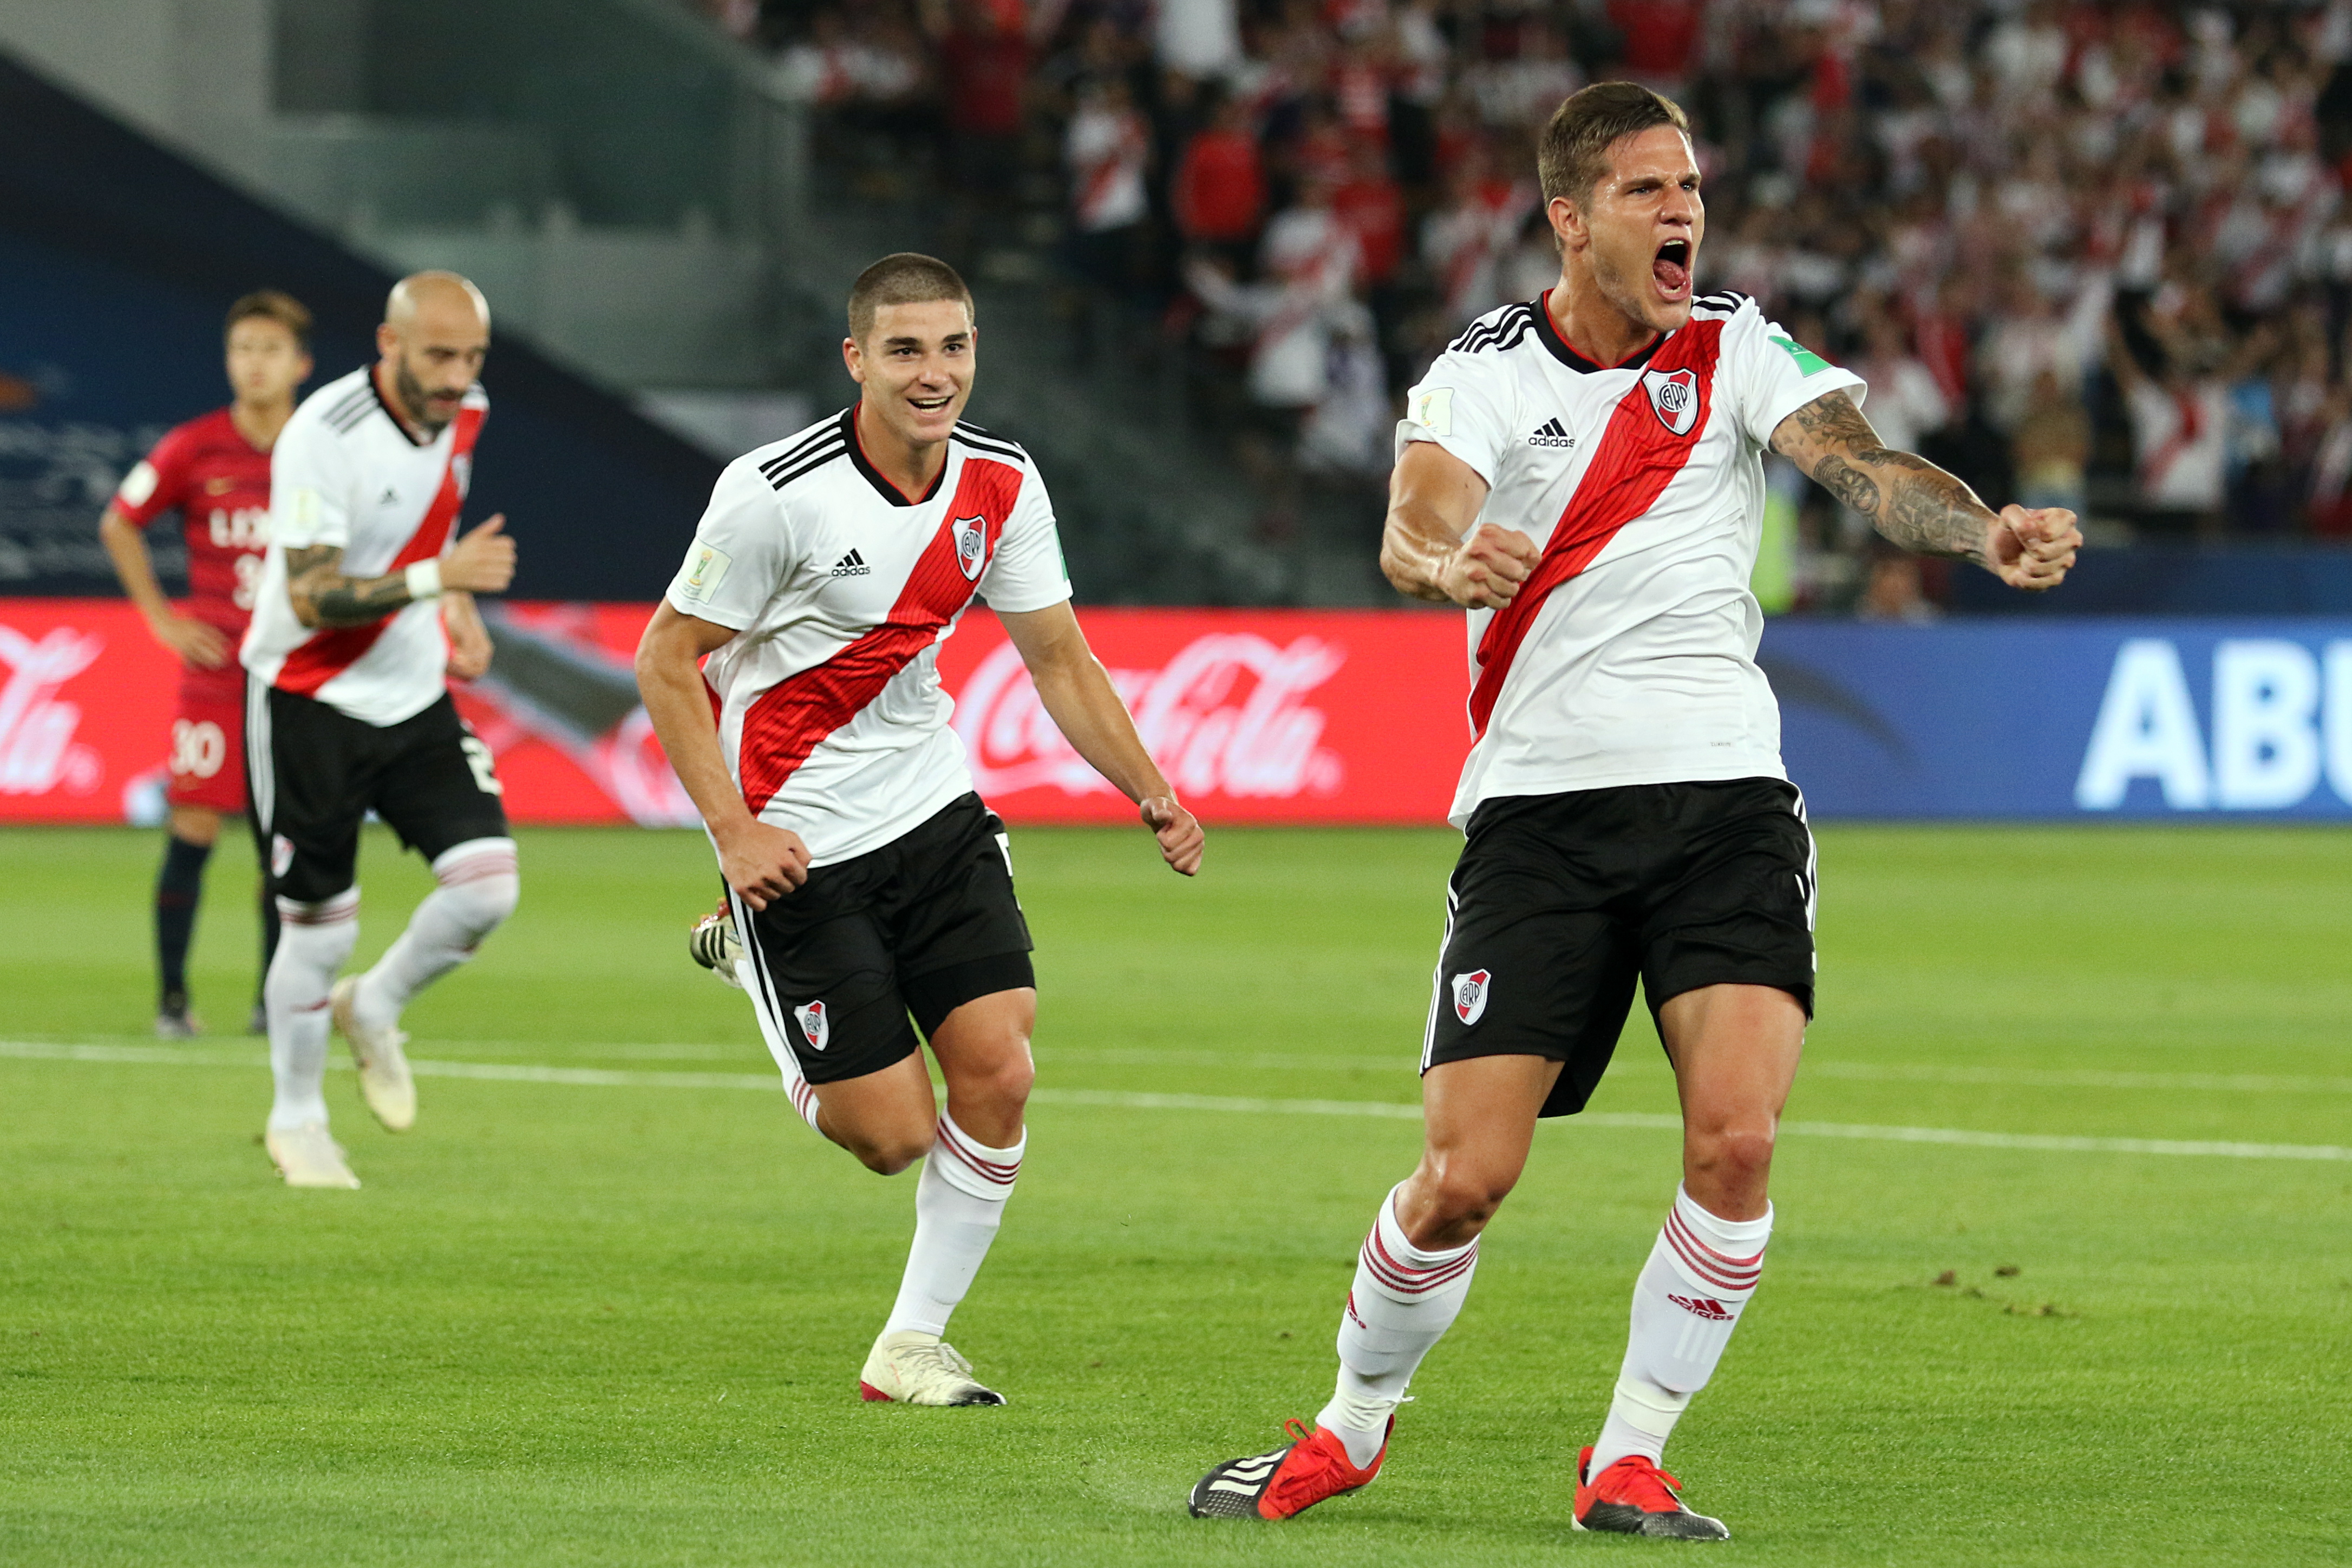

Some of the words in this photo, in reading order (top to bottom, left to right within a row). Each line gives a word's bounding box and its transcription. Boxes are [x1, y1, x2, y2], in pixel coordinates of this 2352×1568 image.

[1658, 383, 1688, 411] CARP
[1528, 435, 1575, 448] adidas
[832, 565, 871, 577] adidas
[168, 717, 226, 779] 30
[1459, 982, 1480, 1006] CARP
[1667, 1293, 1735, 1321] adidas
